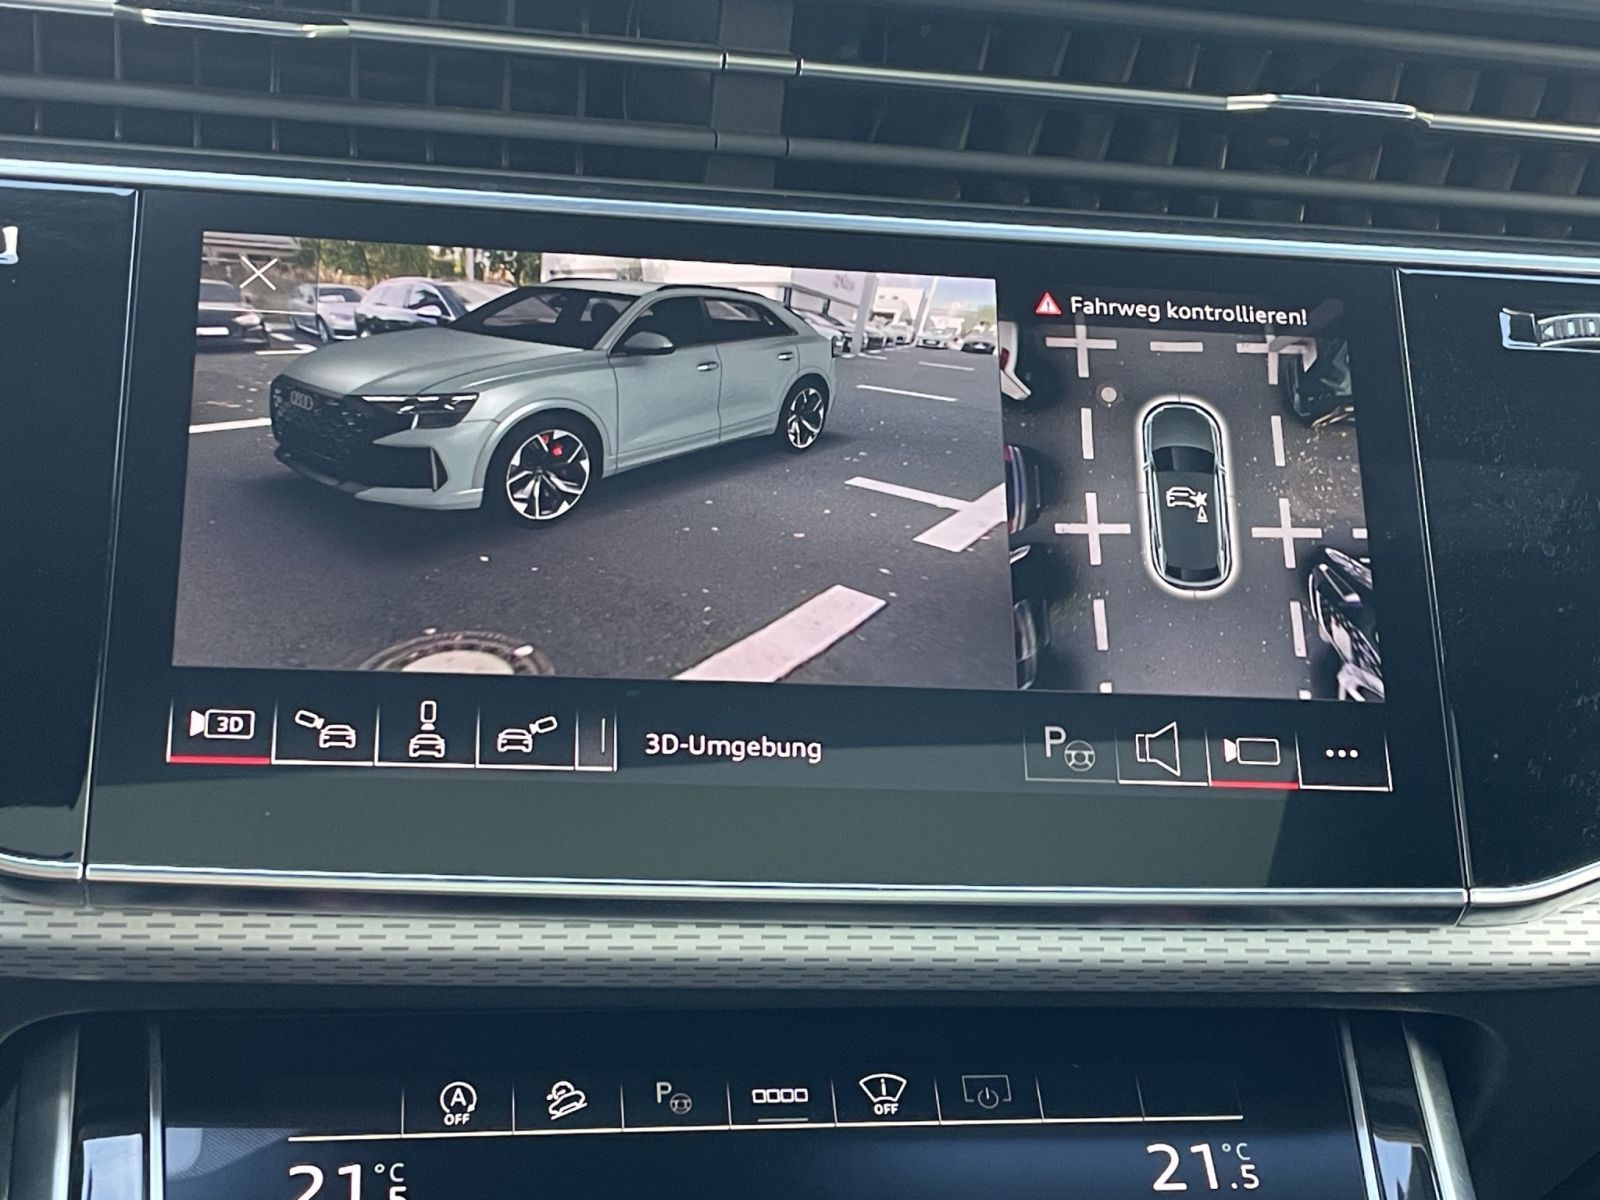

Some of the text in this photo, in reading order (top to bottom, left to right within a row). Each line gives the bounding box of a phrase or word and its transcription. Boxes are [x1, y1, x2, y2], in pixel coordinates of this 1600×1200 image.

[1070, 296, 1308, 326] Fahrweg kontrollieren!
[216, 716, 244, 733] 3D
[645, 732, 823, 764] 3D-Umgebung
[1044, 726, 1067, 758] P
[656, 1082, 672, 1103] P
[444, 1113, 471, 1126] OFF
[873, 1103, 898, 1115] OFF
